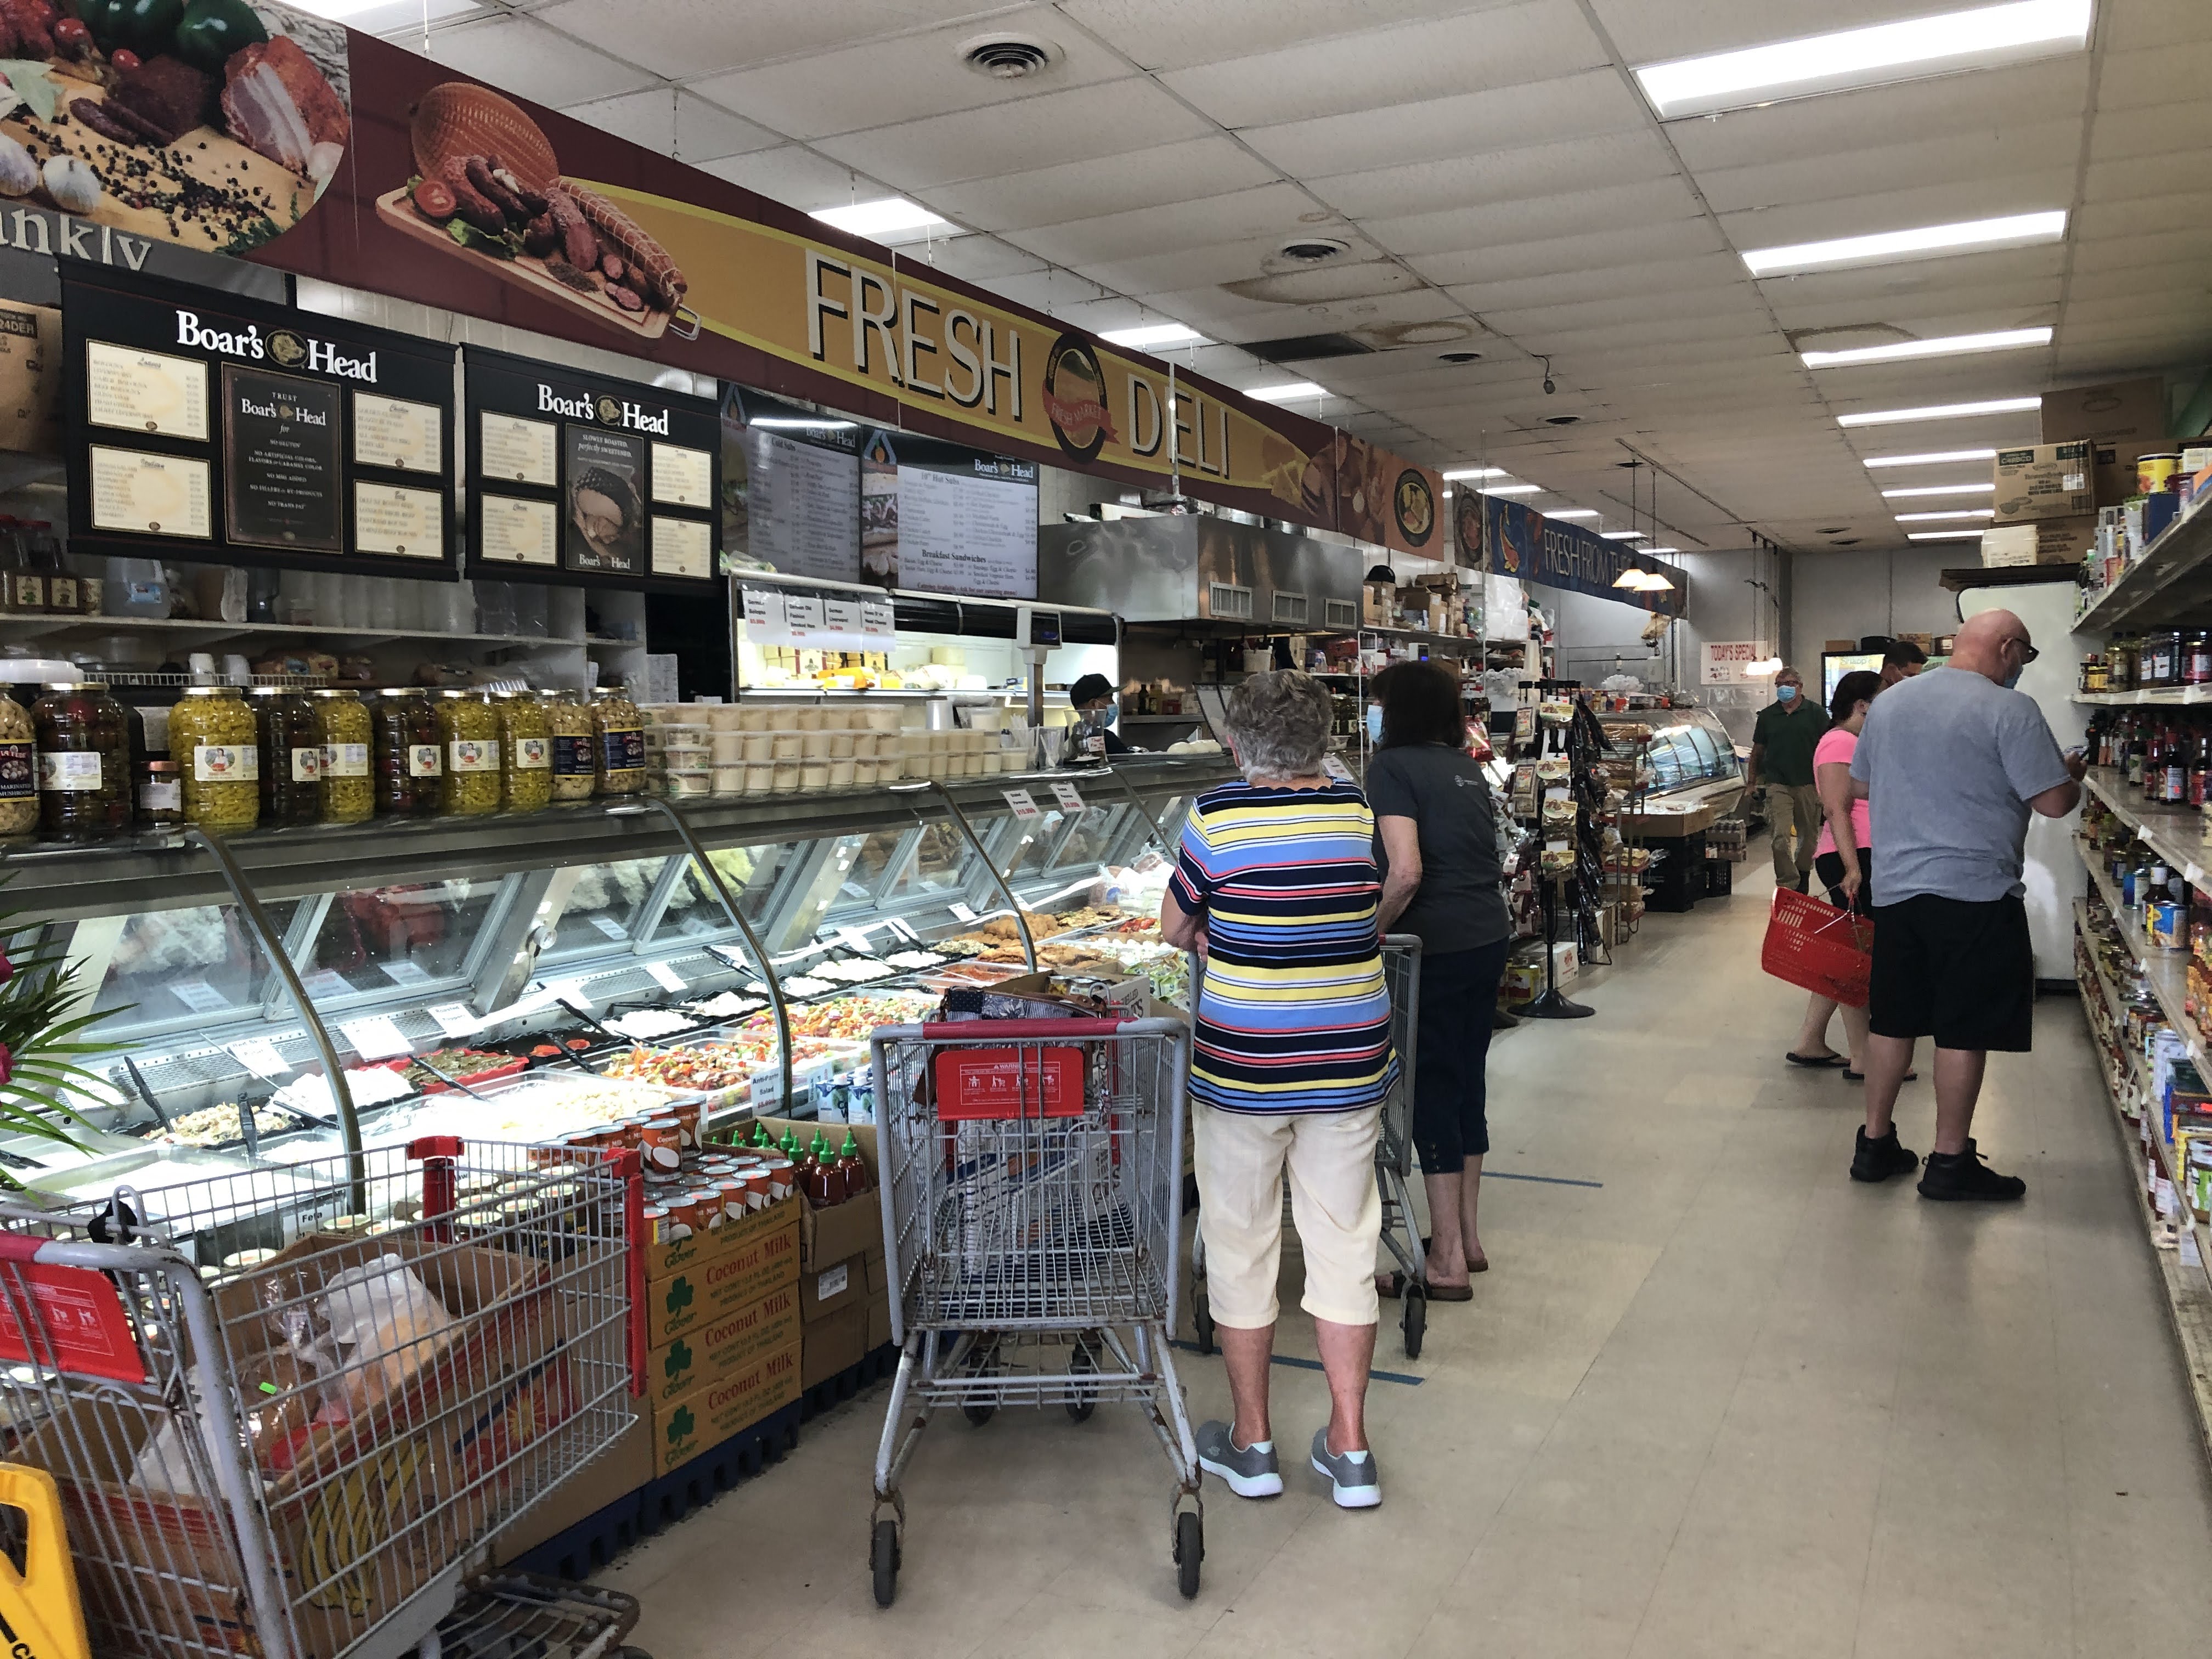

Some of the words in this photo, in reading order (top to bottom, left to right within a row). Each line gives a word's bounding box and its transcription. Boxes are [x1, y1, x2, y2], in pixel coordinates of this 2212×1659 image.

[176, 311, 264, 359] Boar's
[307, 340, 377, 384] Head
[805, 248, 1021, 422] FRESH
[1127, 374, 1229, 479] DELI
[241, 398, 276, 419] Boar's
[296, 407, 326, 426] Head
[272, 392, 297, 402] TRUST
[538, 383, 594, 420] Boar's
[622, 402, 668, 435] Head
[1052, 403, 1073, 426] FRESH
[279, 424, 290, 434] for
[974, 459, 998, 474] Boar's
[1011, 464, 1033, 478] Head
[922, 549, 950, 560] Breakfast
[951, 552, 986, 563] Sandwiches
[1544, 528, 1580, 577] FRESH
[1582, 540, 1609, 585] FROM
[759, 1086, 774, 1096] Salad
[707, 1249, 760, 1285] Coconut
[763, 1234, 792, 1260] Milk
[705, 1308, 759, 1347] Coconut
[763, 1293, 791, 1319] Milk
[708, 1369, 761, 1410] Coconut
[766, 1351, 794, 1378] Milk
